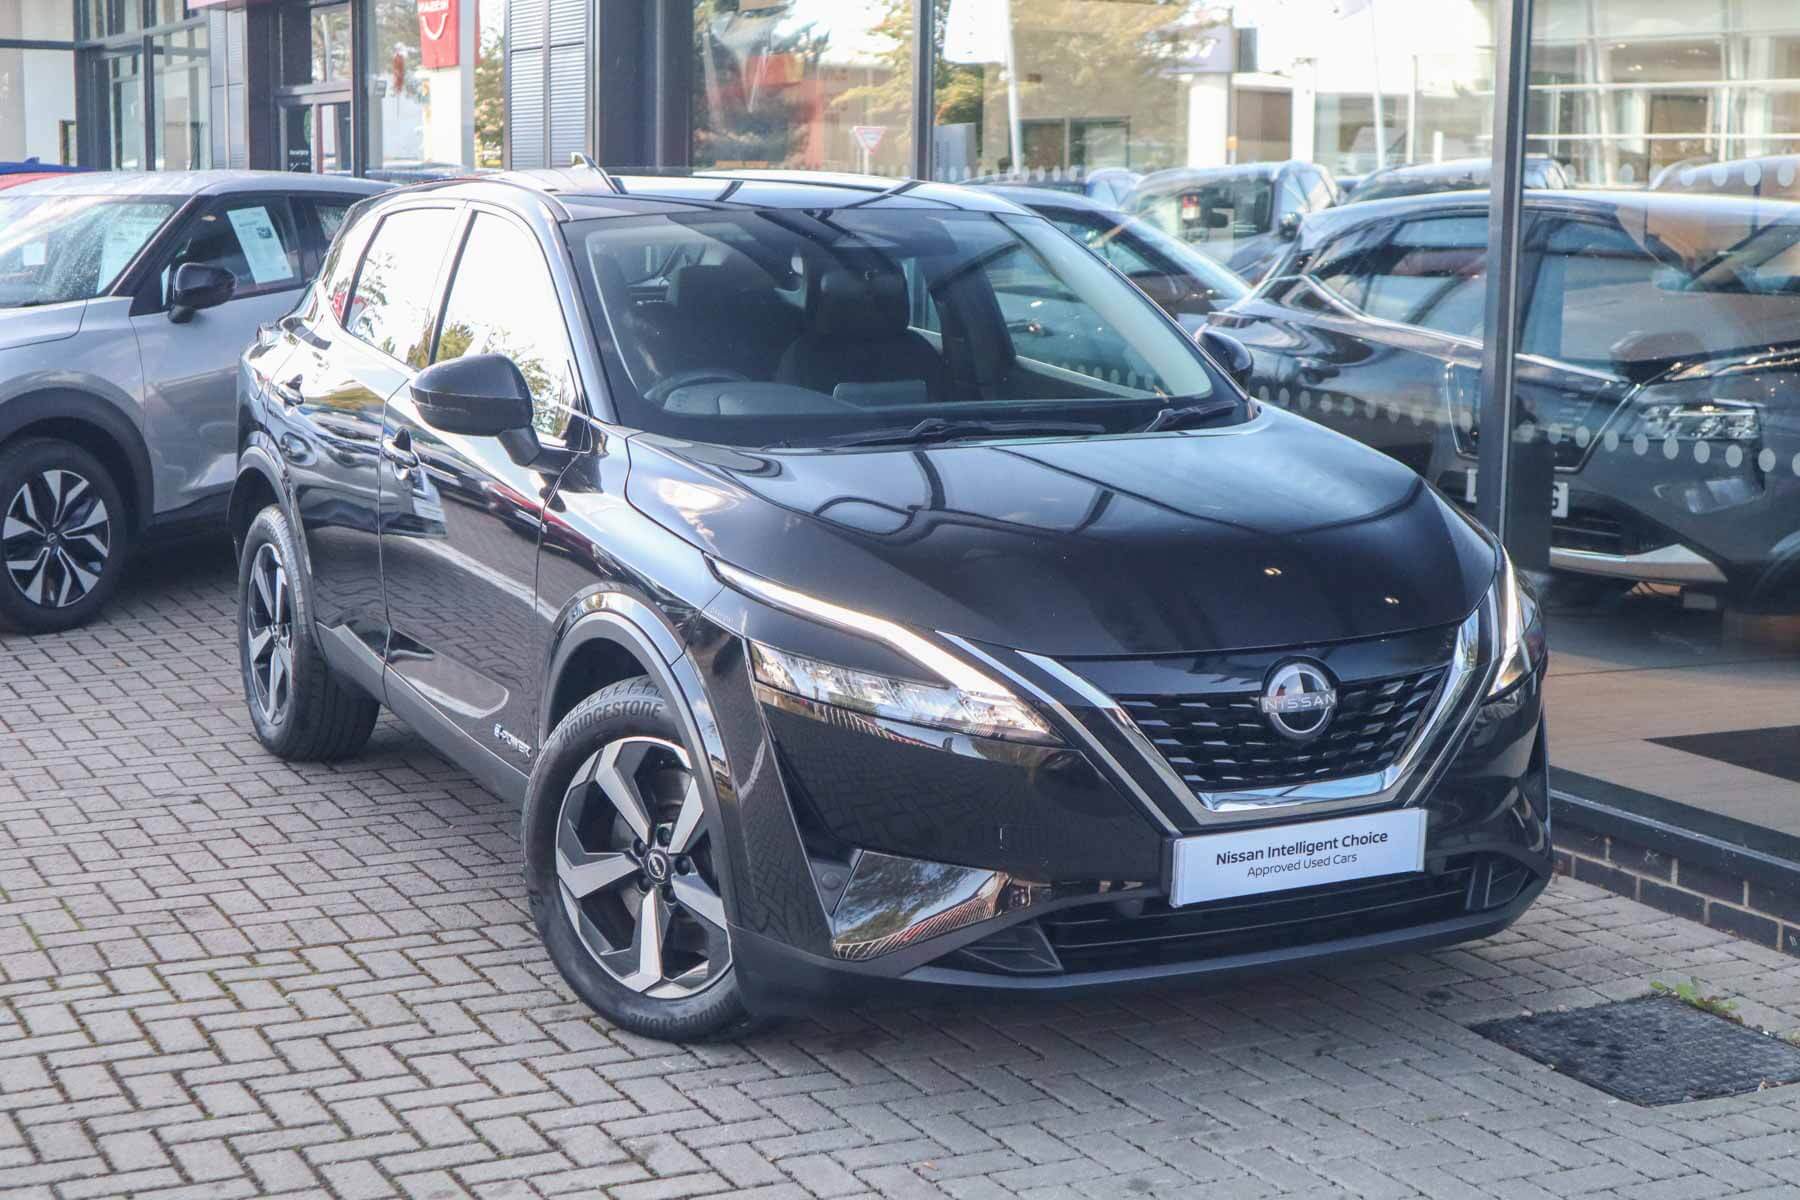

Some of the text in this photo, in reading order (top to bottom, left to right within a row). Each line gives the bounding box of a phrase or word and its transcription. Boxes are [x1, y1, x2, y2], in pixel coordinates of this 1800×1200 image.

[1264, 693, 1336, 710] NISSAN
[1216, 831, 1388, 866] Nissan Intelligent Choice
[1247, 852, 1358, 878] Approved Used Cars
